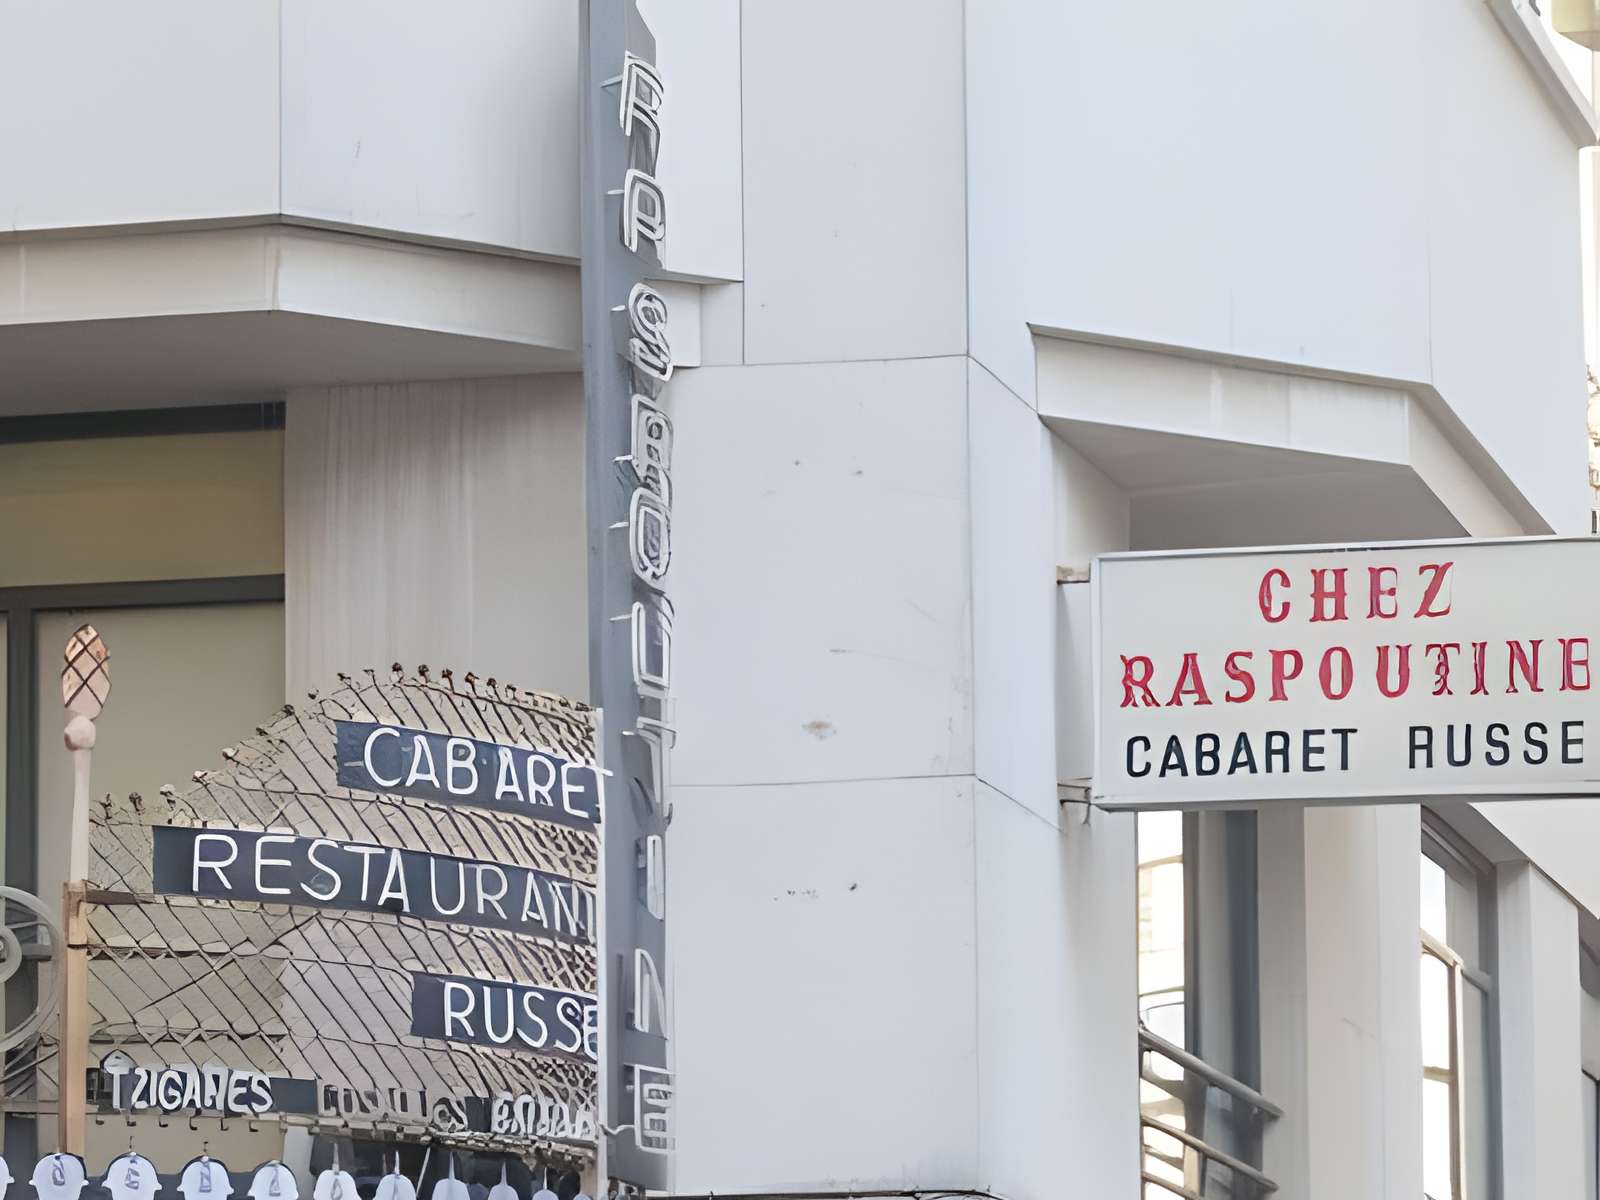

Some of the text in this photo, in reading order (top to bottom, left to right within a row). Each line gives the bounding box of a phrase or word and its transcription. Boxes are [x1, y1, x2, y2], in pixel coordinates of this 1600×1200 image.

[1258, 561, 1454, 624] CHEZ
[1119, 637, 1591, 708] RASPOUTINE
[1125, 720, 1585, 779] CABARET RUSSE
